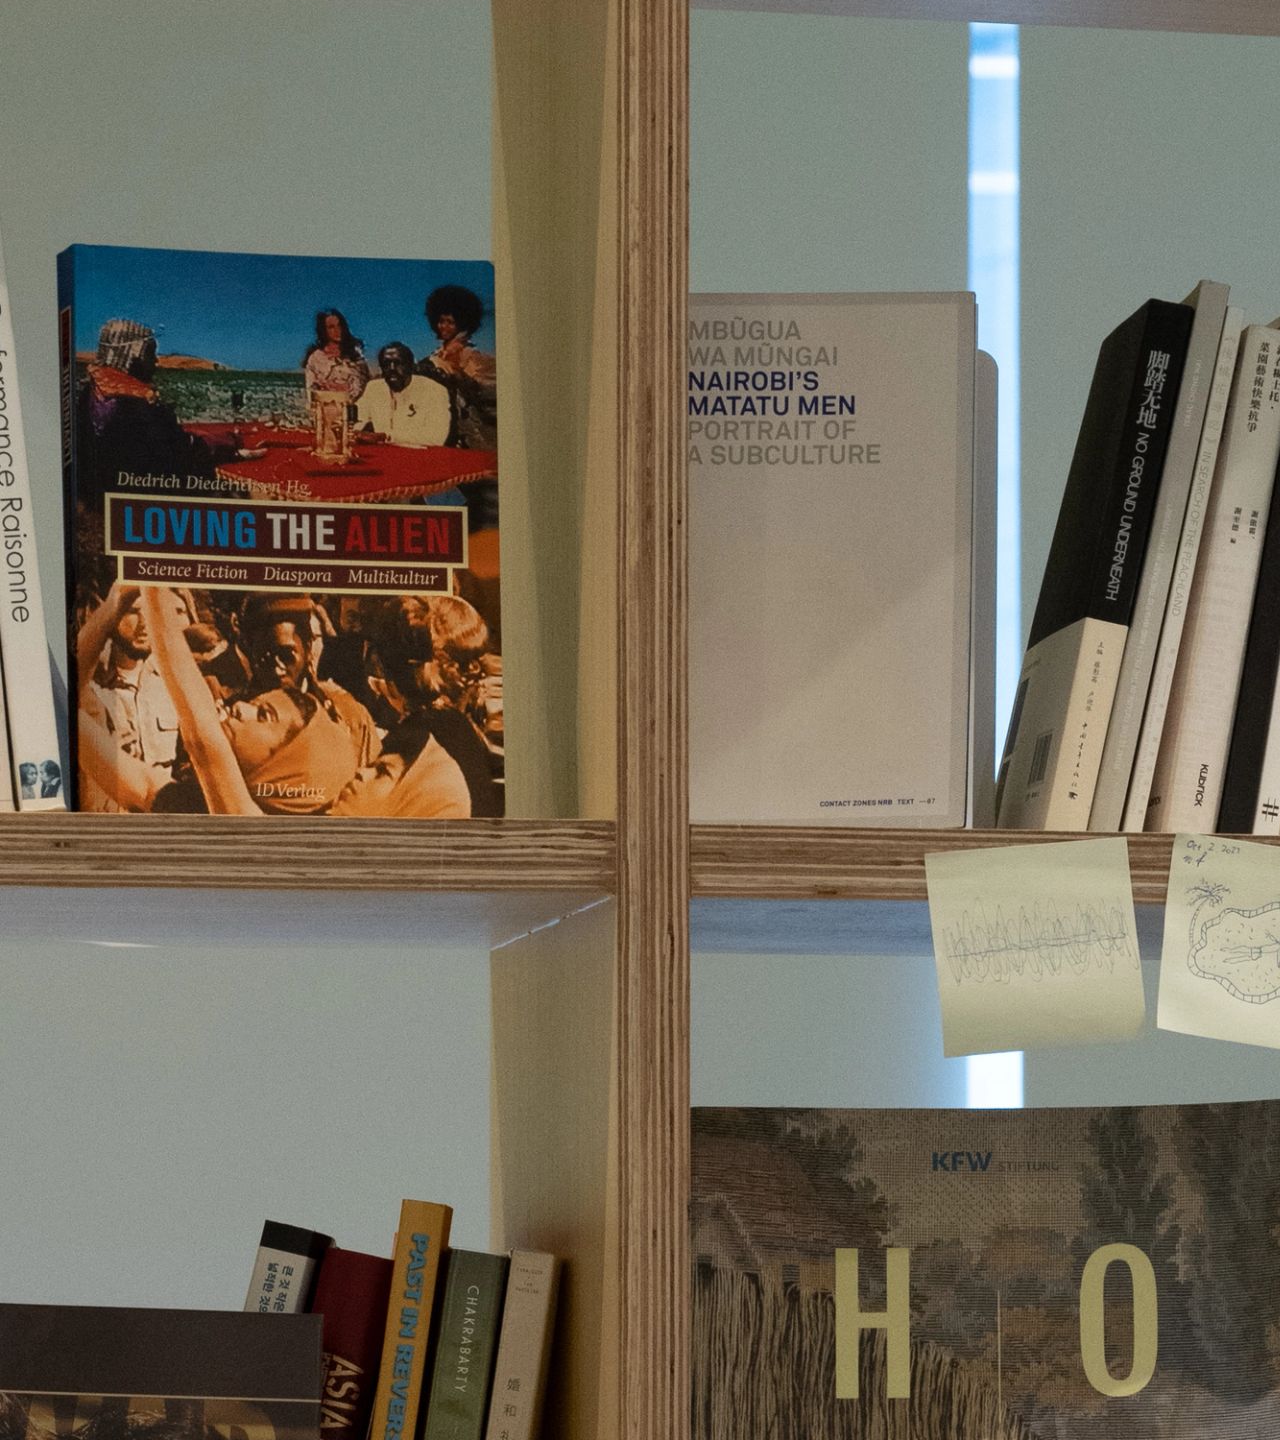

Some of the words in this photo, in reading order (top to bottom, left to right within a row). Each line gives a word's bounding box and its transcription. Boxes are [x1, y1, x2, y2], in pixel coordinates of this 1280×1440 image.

[689, 371, 818, 390] NAIROBI’S
[1137, 350, 1170, 429] 脚踏无地
[689, 396, 788, 415] MATATU
[799, 396, 854, 415] MEN
[123, 508, 257, 548] LOVING
[268, 511, 336, 550] THE
[346, 514, 452, 552] ALIEN
[403, 1231, 430, 1304] PAST
[399, 1307, 419, 1339] IN
[455, 1285, 479, 1392] CHAKRABARTY
